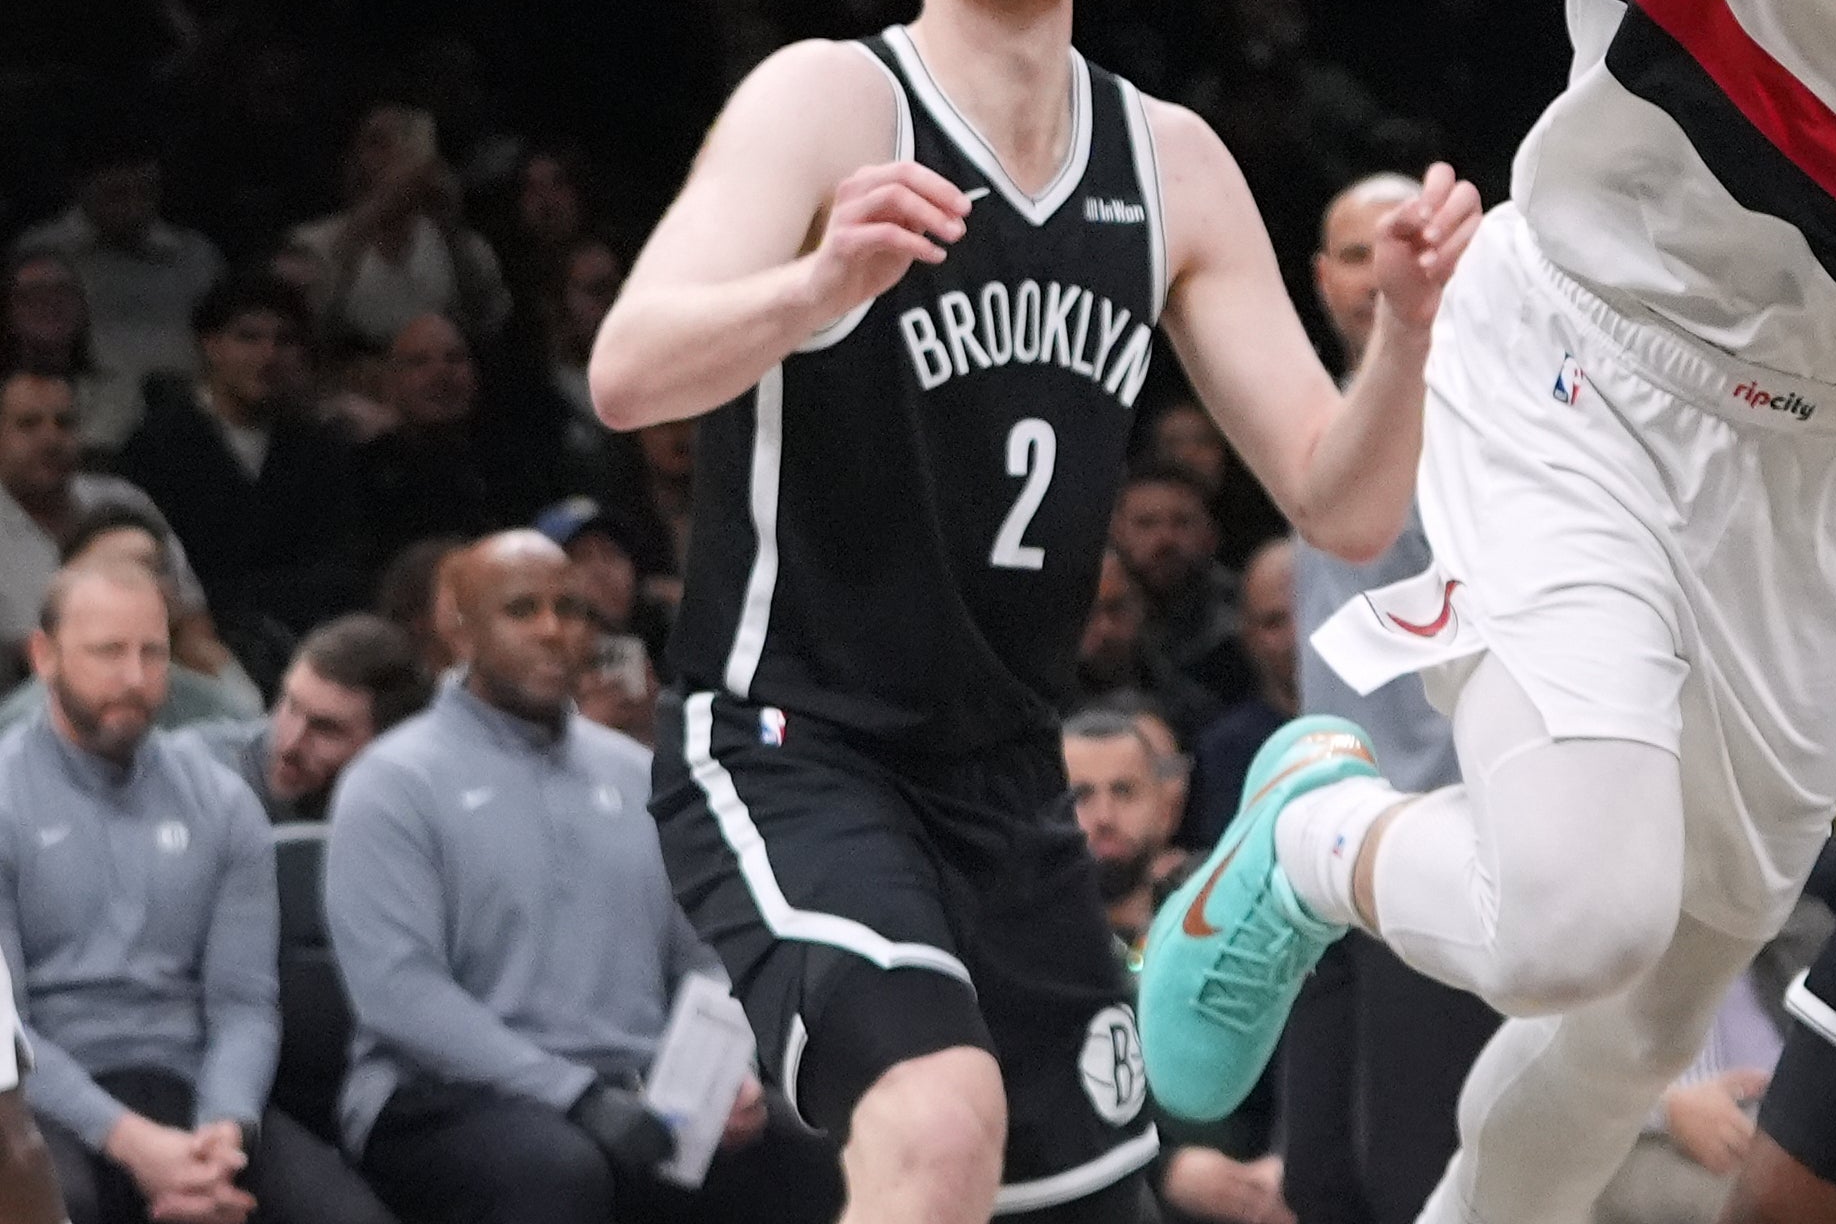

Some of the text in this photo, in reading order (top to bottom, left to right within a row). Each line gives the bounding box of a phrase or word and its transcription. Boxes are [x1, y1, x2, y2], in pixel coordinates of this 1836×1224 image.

[901, 278, 1153, 408] BROOKLYN
[1733, 379, 1816, 421] ripcity
[990, 416, 1057, 571] 2
